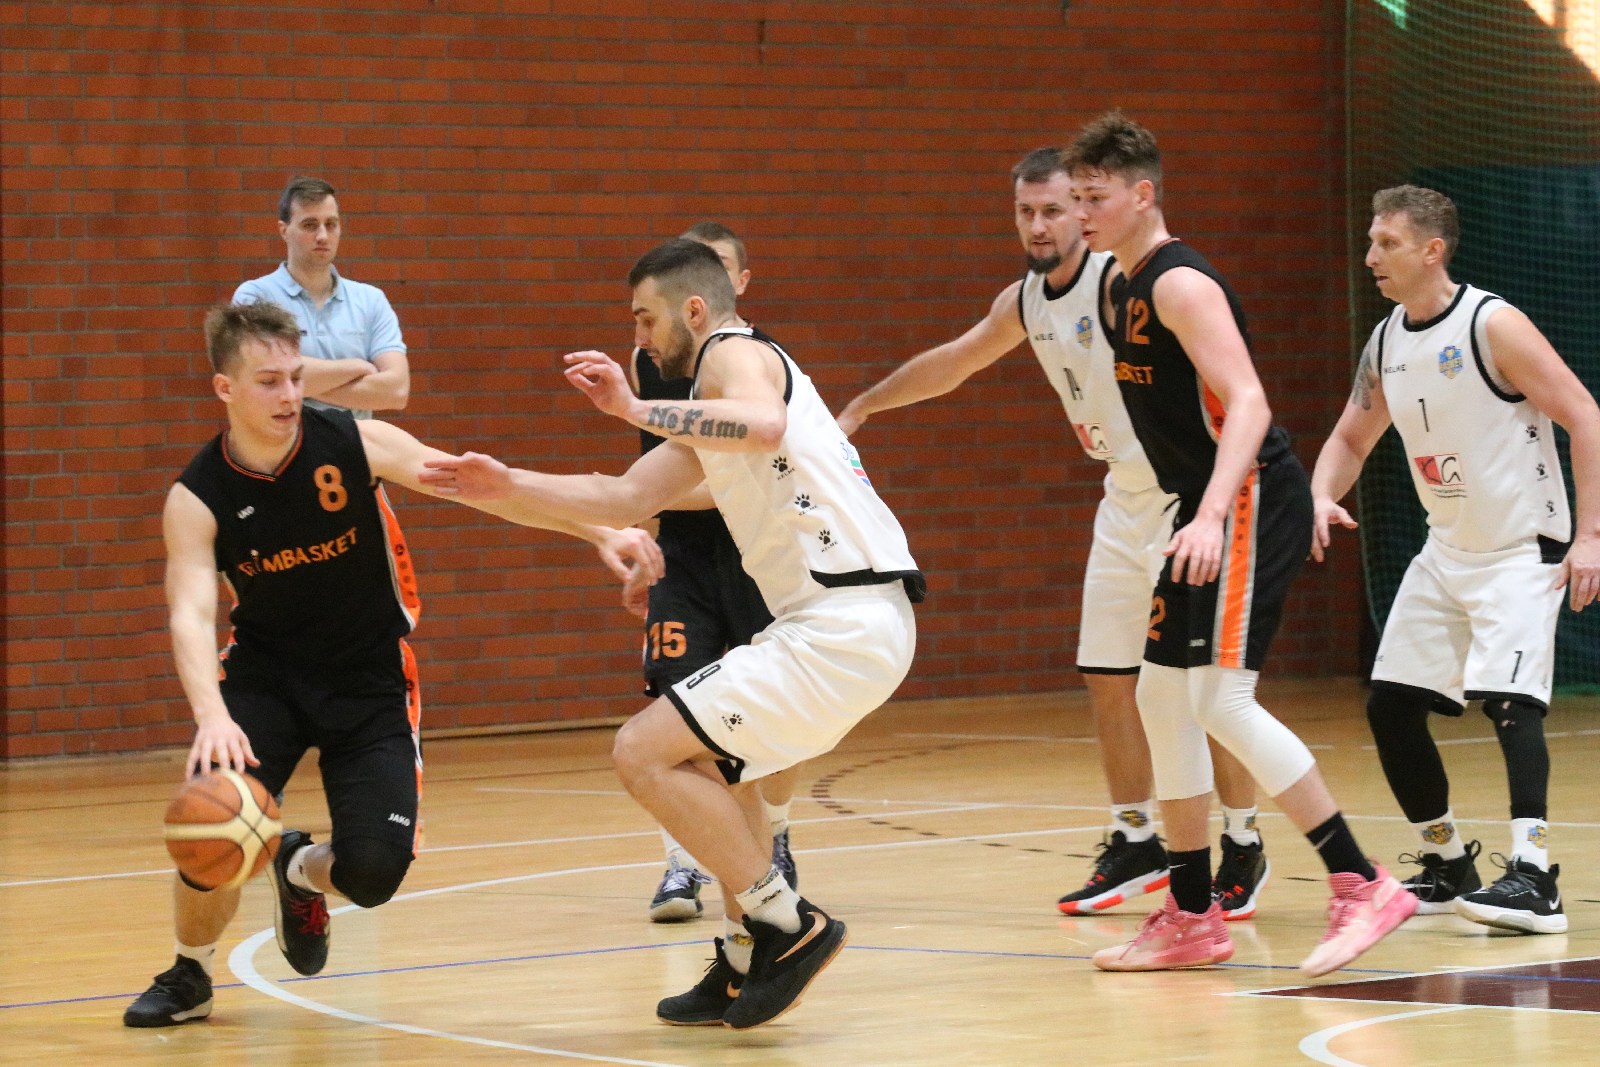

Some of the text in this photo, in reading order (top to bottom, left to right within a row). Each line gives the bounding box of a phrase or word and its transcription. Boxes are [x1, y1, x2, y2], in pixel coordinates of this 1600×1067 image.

[1124, 295, 1151, 346] 12
[1418, 398, 1430, 433] 1
[313, 464, 348, 512] 8
[648, 620, 688, 661] 15
[1511, 650, 1523, 684] 1
[387, 812, 411, 827] JAKO
